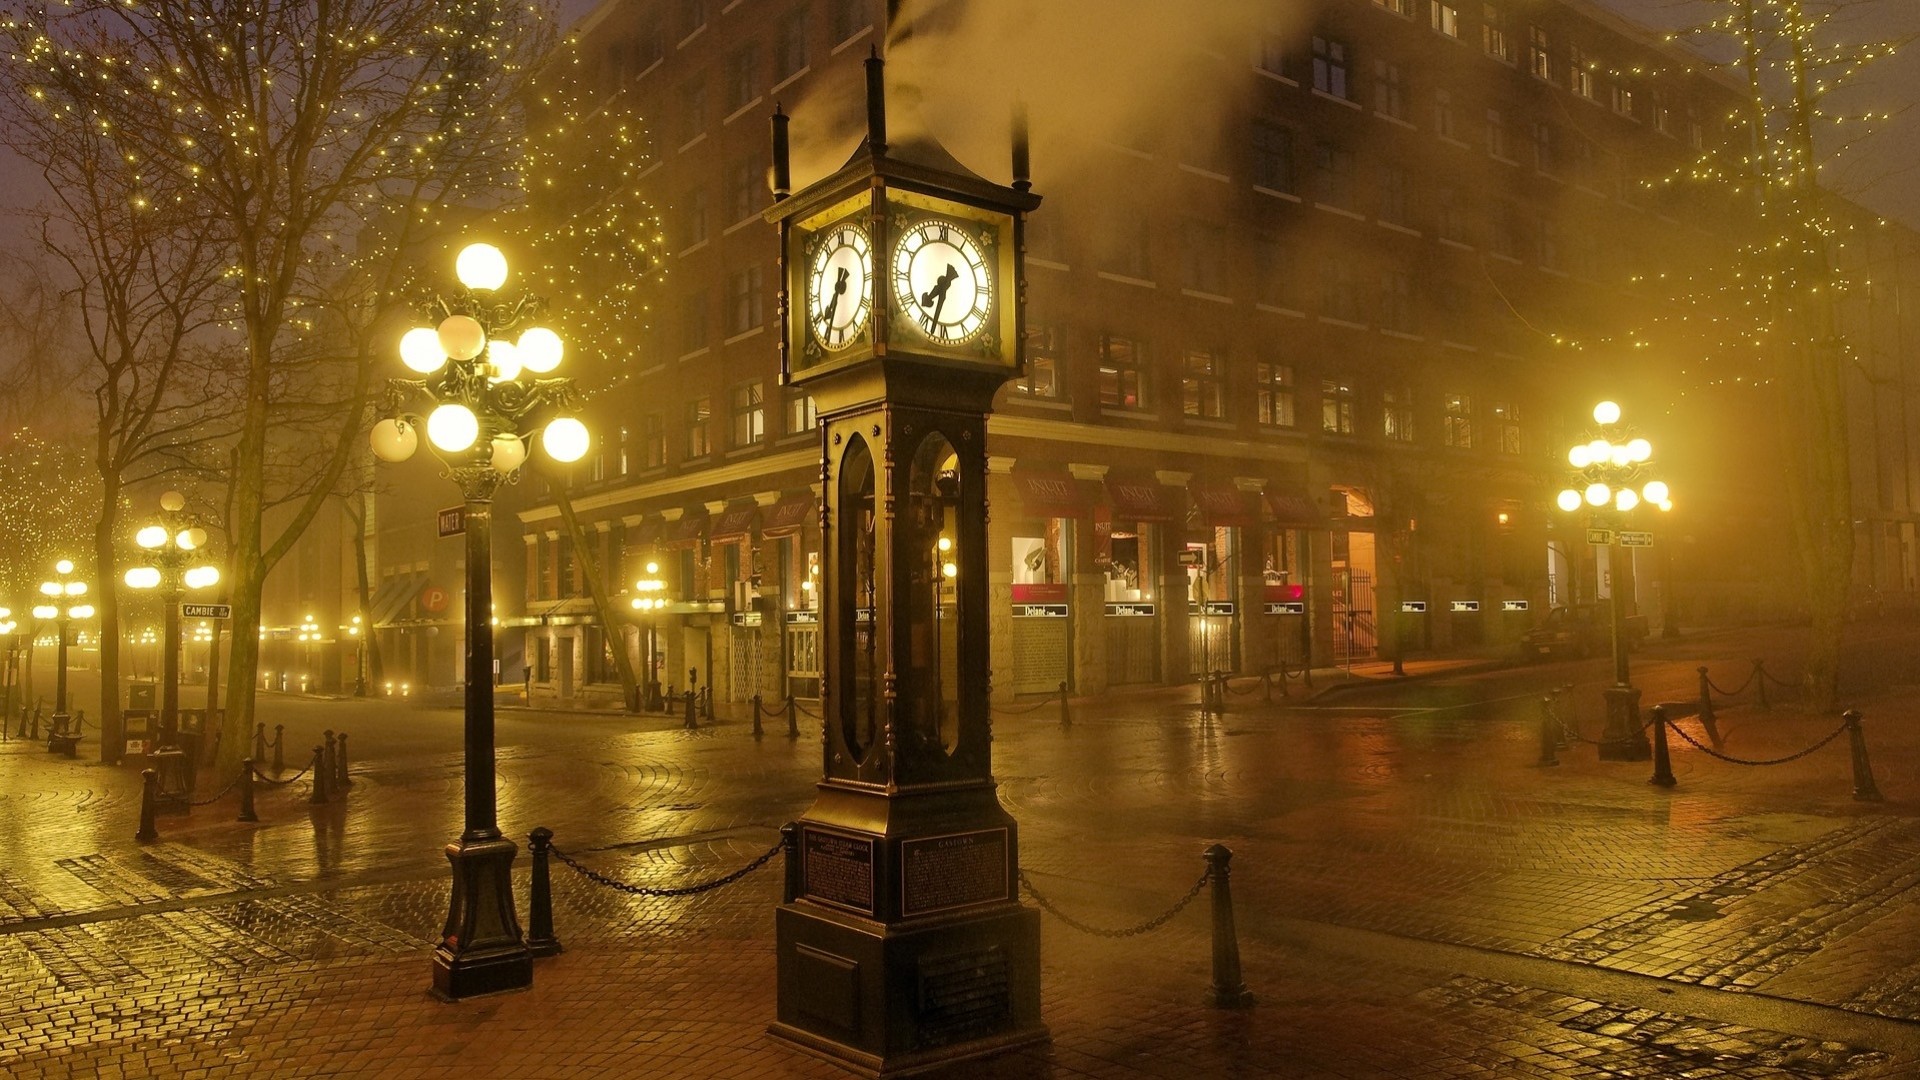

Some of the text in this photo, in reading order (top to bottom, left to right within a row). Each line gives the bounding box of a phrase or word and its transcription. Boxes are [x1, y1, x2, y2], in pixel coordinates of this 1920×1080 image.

[441, 512, 459, 532] WATER
[430, 591, 443, 608] P
[186, 606, 214, 616] CAMBIE
[938, 837, 974, 848] GASTOWN
